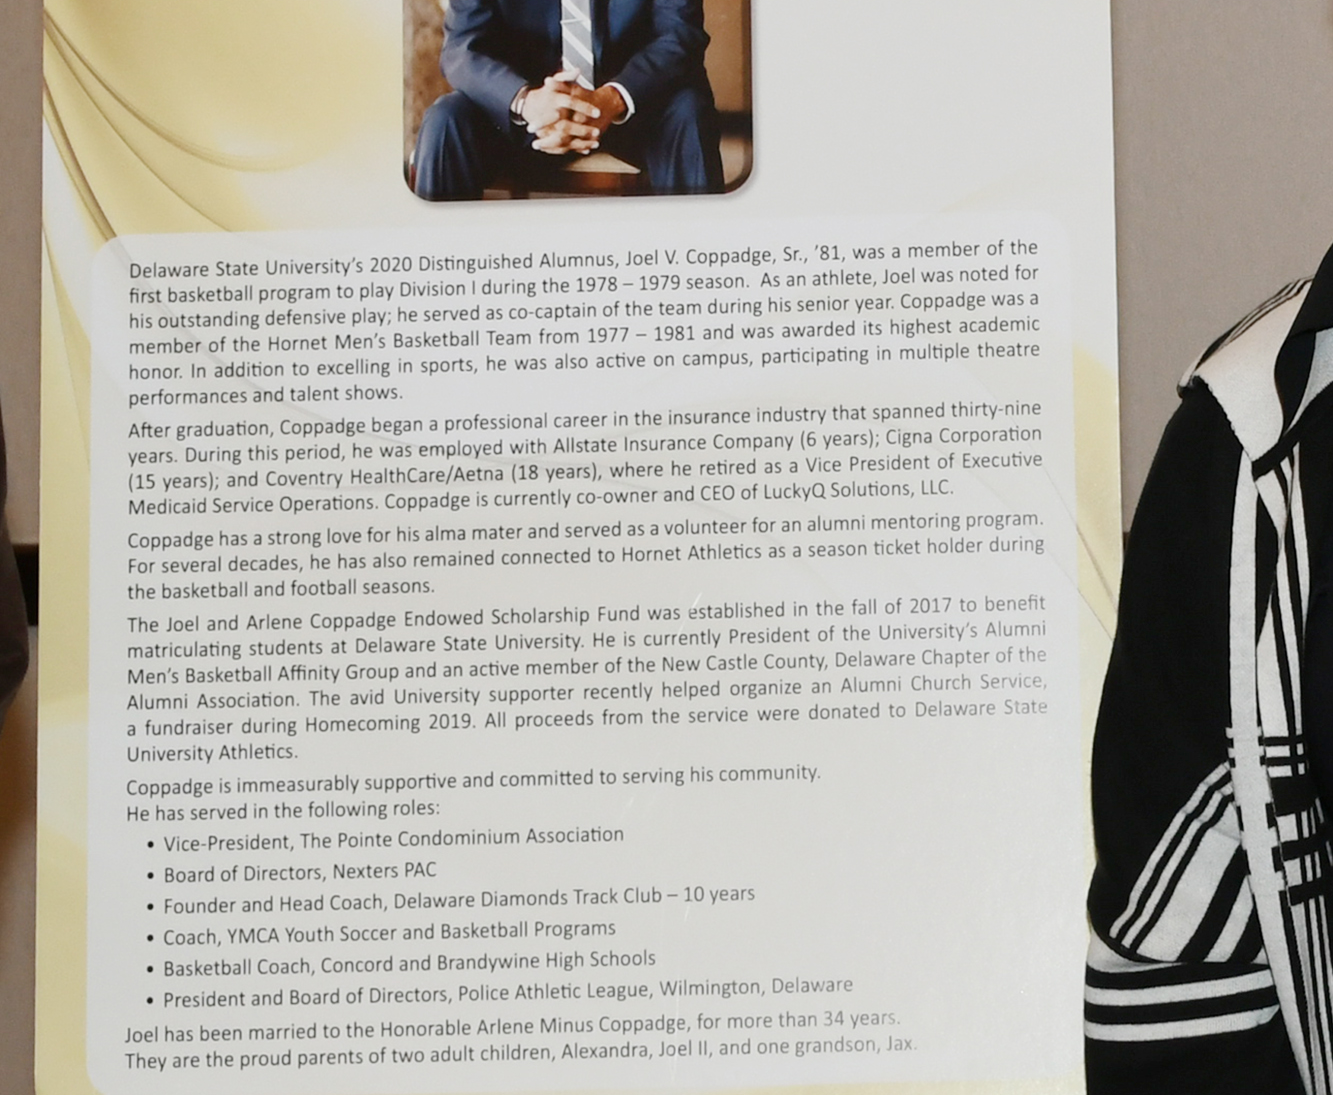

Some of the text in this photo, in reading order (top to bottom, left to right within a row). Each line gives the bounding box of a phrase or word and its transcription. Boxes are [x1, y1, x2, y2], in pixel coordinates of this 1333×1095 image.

[129, 261, 210, 280] Delaware
[215, 260, 260, 278] State
[369, 255, 413, 274] 2020
[418, 251, 534, 275] Distinguished
[538, 251, 620, 270] Alumnus,
[624, 248, 659, 268] Joel
[664, 248, 680, 266] V.
[685, 245, 777, 268] Coppadge,
[782, 245, 809, 266] Sr.,
[851, 246, 886, 261] was
[891, 246, 901, 260] a
[907, 239, 981, 260] member
[986, 238, 1005, 257] of
[1009, 237, 1039, 257] the
[128, 290, 1039, 331] his outstanding defensive play; he served as co-captain of the team during his senior year. Coppadge was a
[128, 383, 404, 411] performances and talent shows.
[127, 449, 1043, 494] (15 years); and Coventry HealthCare/Aetna (18 years), where he retired as a Vice President of Executive
[127, 535, 1045, 575] For several decades, he has also remained connected to Hornet Athletics as a season ticket holder during
[127, 639, 242, 661] matriculating
[248, 638, 324, 658] students
[330, 638, 348, 655] at
[355, 635, 437, 655] Delaware
[442, 634, 488, 653] State
[494, 631, 585, 653] University.
[592, 630, 616, 649] He
[623, 630, 637, 648] is
[642, 628, 722, 650] currently
[728, 625, 811, 646] President
[817, 623, 836, 643] of
[841, 623, 871, 642] the
[984, 619, 1046, 638] Alumni
[126, 742, 299, 766] University Athletics.
[126, 798, 441, 823] He has served in the following roles:
[163, 825, 625, 853] Vice-President, The Pointe Condominium Association
[164, 860, 437, 885] Board of Directors, Nexters PAC
[163, 919, 617, 949] Coach, YMCA Youth Soccer and Basketball Programs
[163, 948, 657, 978] Basketball Coach, Concord and Brandywine High Schools
[123, 1035, 919, 1073] They are the proud parents of two adult children, Alexandra, Joel II, and one grandson, Jax.
